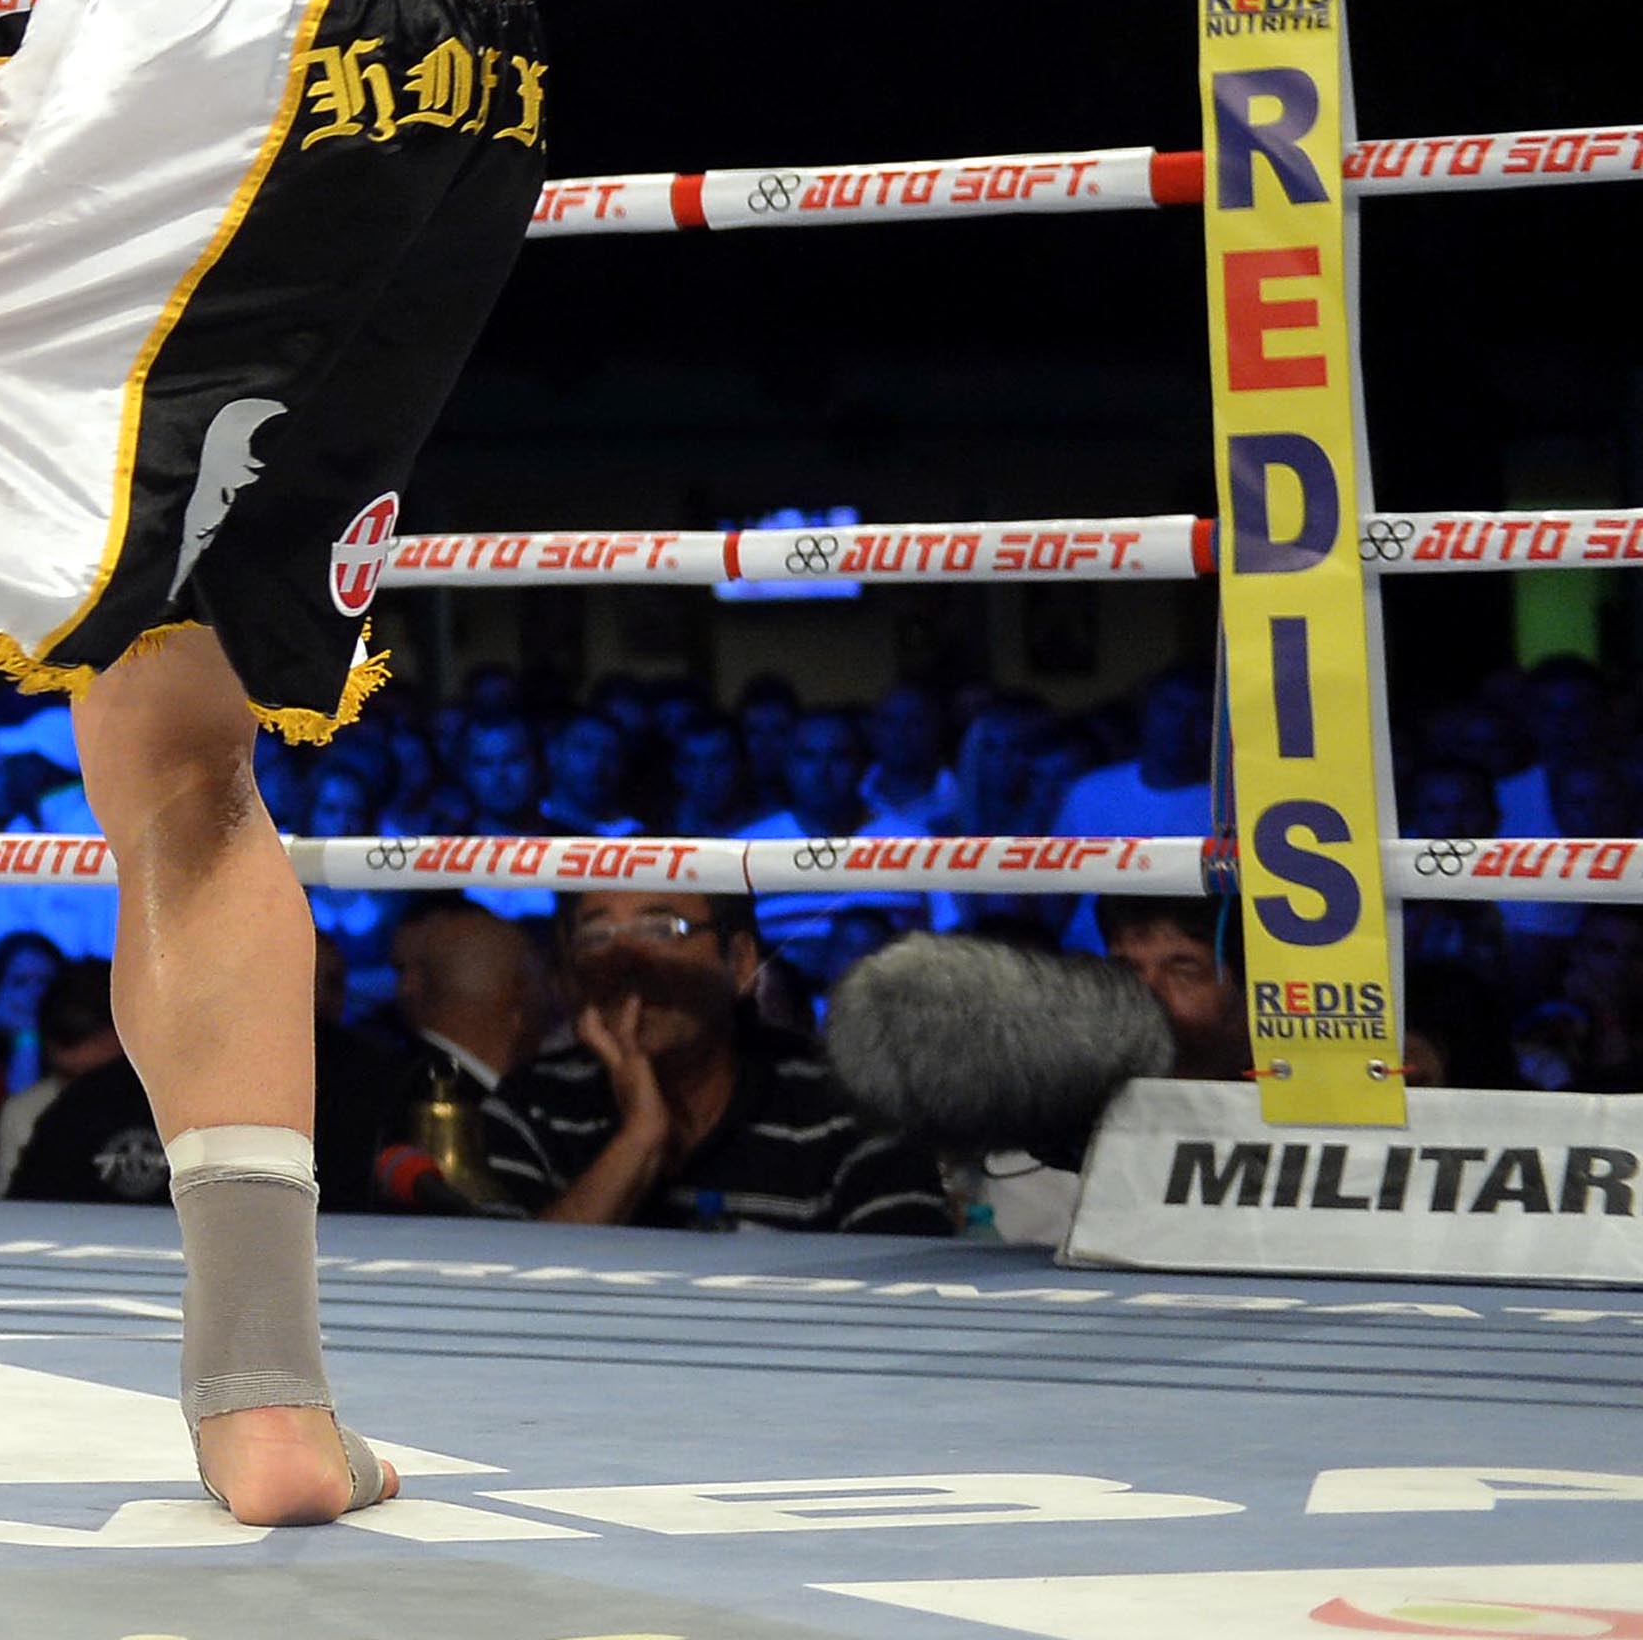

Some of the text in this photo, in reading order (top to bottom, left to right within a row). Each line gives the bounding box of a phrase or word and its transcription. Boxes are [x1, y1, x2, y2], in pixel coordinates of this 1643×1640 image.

[1205, 10, 1332, 38] NUTRITIE
[1211, 66, 1362, 948] REDIS
[1256, 980, 1385, 1014] REDIS
[1256, 1015, 1388, 1042] NUTRITIE
